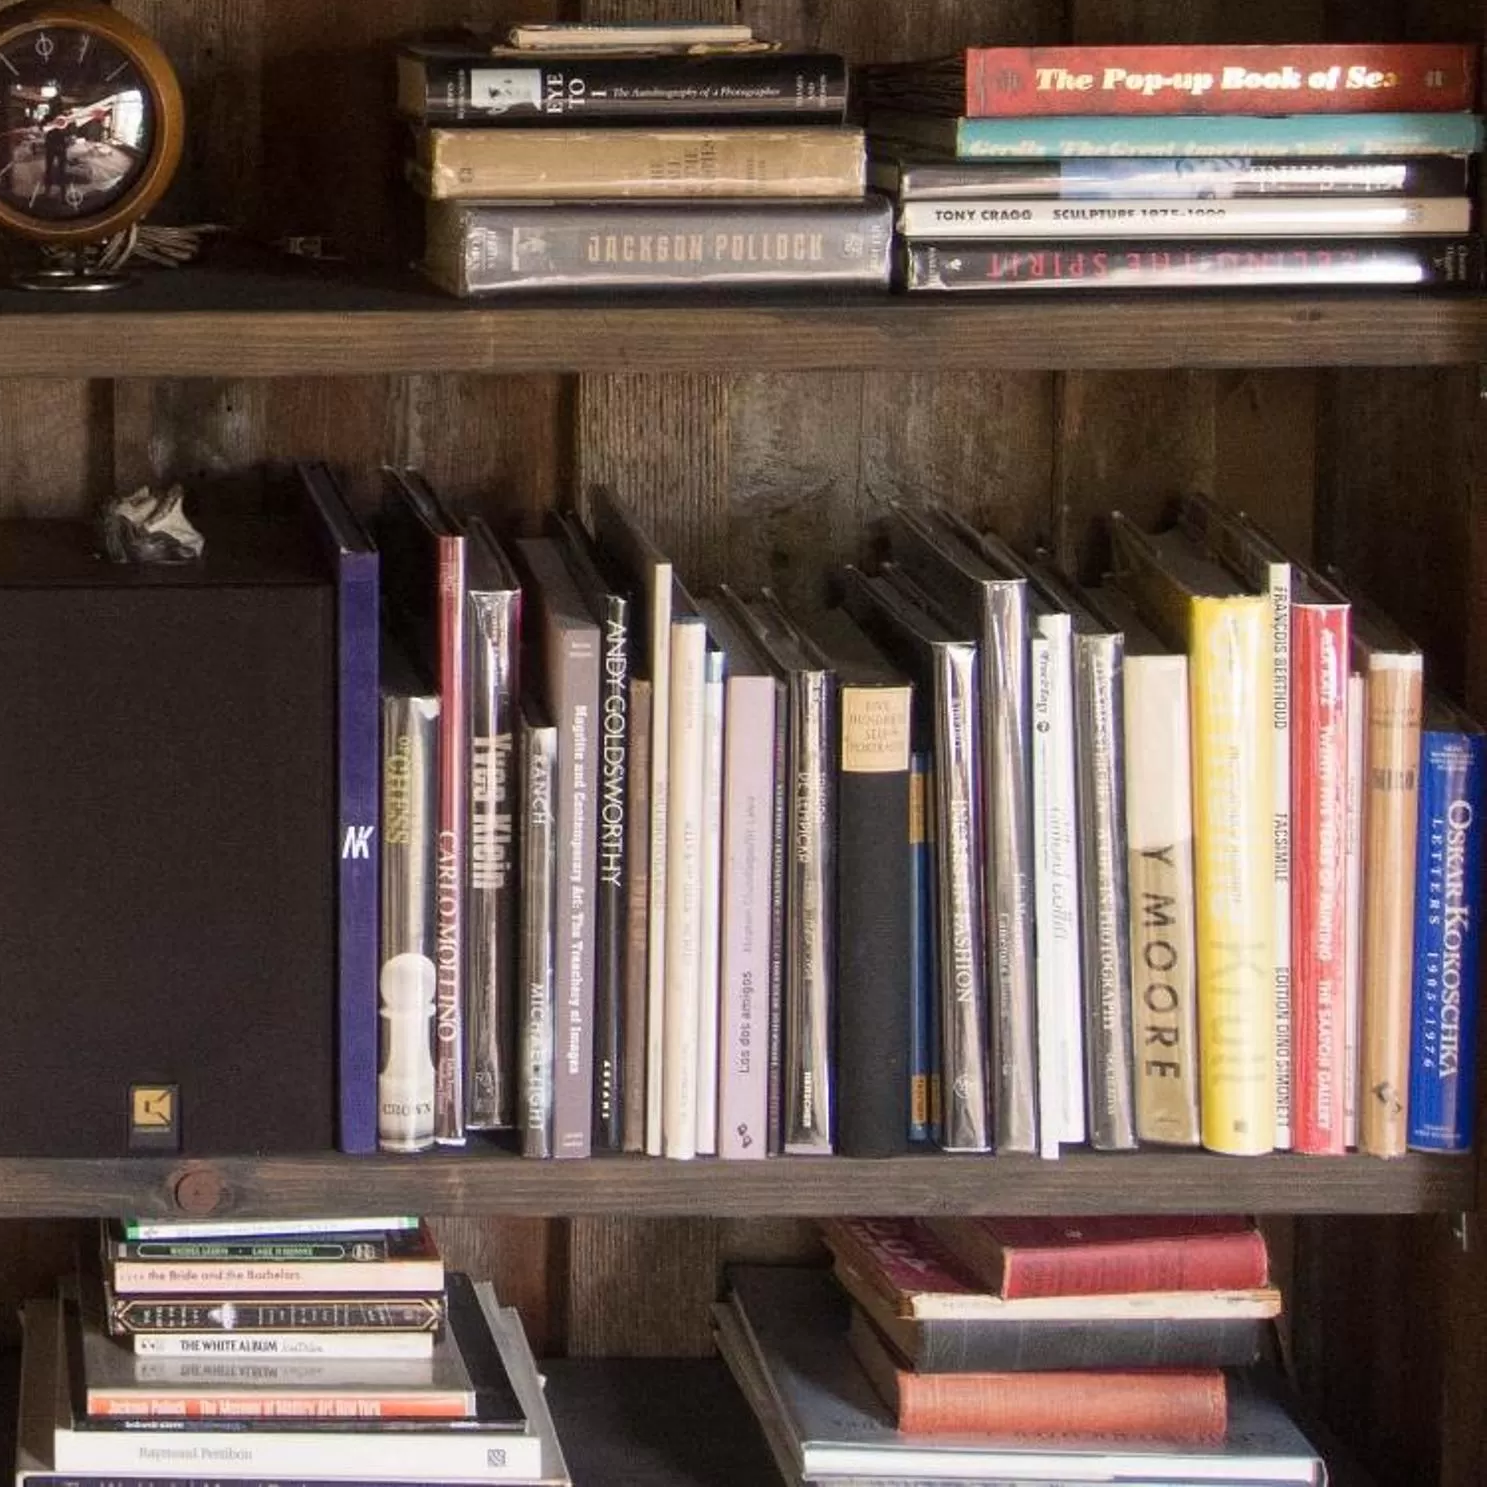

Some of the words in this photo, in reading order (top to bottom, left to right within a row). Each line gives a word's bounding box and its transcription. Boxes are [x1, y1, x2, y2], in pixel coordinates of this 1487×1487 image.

[546, 73, 563, 115] EYE
[568, 77, 586, 110] TO
[613, 88, 630, 98] The
[720, 86, 781, 99] Photographer
[1035, 68, 1094, 91] The
[1102, 67, 1214, 96] Pop-up
[1221, 66, 1302, 90] Book
[1308, 66, 1342, 92] of
[935, 209, 976, 221] TONY
[980, 209, 1034, 221] CRAGG
[1052, 208, 1140, 220] SCULPTURE
[587, 233, 704, 263] JACKSON
[714, 233, 826, 261] POLLOCK
[986, 249, 1110, 279] SPIRIT
[1269, 585, 1288, 654] FRANÇOIS
[606, 620, 628, 689] ANDY
[1272, 656, 1288, 731] BERTHOUD
[571, 704, 588, 761] Magritte
[473, 732, 513, 802] Yves
[531, 754, 548, 825] RANCH
[573, 763, 587, 789] and
[600, 694, 626, 888] GOLDSWORTHY
[385, 754, 411, 845] CHESS
[797, 794, 812, 864] LEMPICKA
[472, 813, 512, 889] Klein
[570, 791, 588, 883] Contemporary
[1273, 812, 1288, 884] FACSIMILE
[1446, 799, 1473, 900] OSKAR
[438, 830, 458, 917] CARLO
[571, 885, 585, 909] Art:
[1429, 818, 1444, 926] LETTERS
[570, 912, 584, 938] The
[953, 910, 973, 1003] FASHION
[1317, 894, 1332, 961] PAINTING
[567, 943, 584, 1007] Treachery
[1100, 909, 1116, 1031] PHOTOGRAPHY
[1142, 892, 1182, 1080] MOORE
[1274, 967, 1290, 1022] EDITION
[1438, 904, 1470, 1079] KOKOSCHKA
[528, 982, 545, 1072] MICHAEL
[568, 1010, 583, 1024] of
[1275, 1023, 1289, 1059] DINO
[566, 1026, 582, 1075] Images
[528, 1075, 545, 1133] LIGHT
[601, 1059, 612, 1120] ABRAMS
[1276, 1060, 1291, 1128] SIMONETT
[1316, 1070, 1332, 1131] GALLERY
[148, 1269, 166, 1281] the
[168, 1269, 199, 1281] Bride
[200, 1269, 223, 1281] and
[225, 1269, 245, 1281] the
[247, 1268, 301, 1282] Bachelors
[180, 1340, 202, 1352] THE
[202, 1340, 238, 1352] WHITE
[237, 1340, 279, 1352] ALBUM
[138, 1446, 199, 1464] Raymond
[200, 1446, 254, 1462] Pettibon
